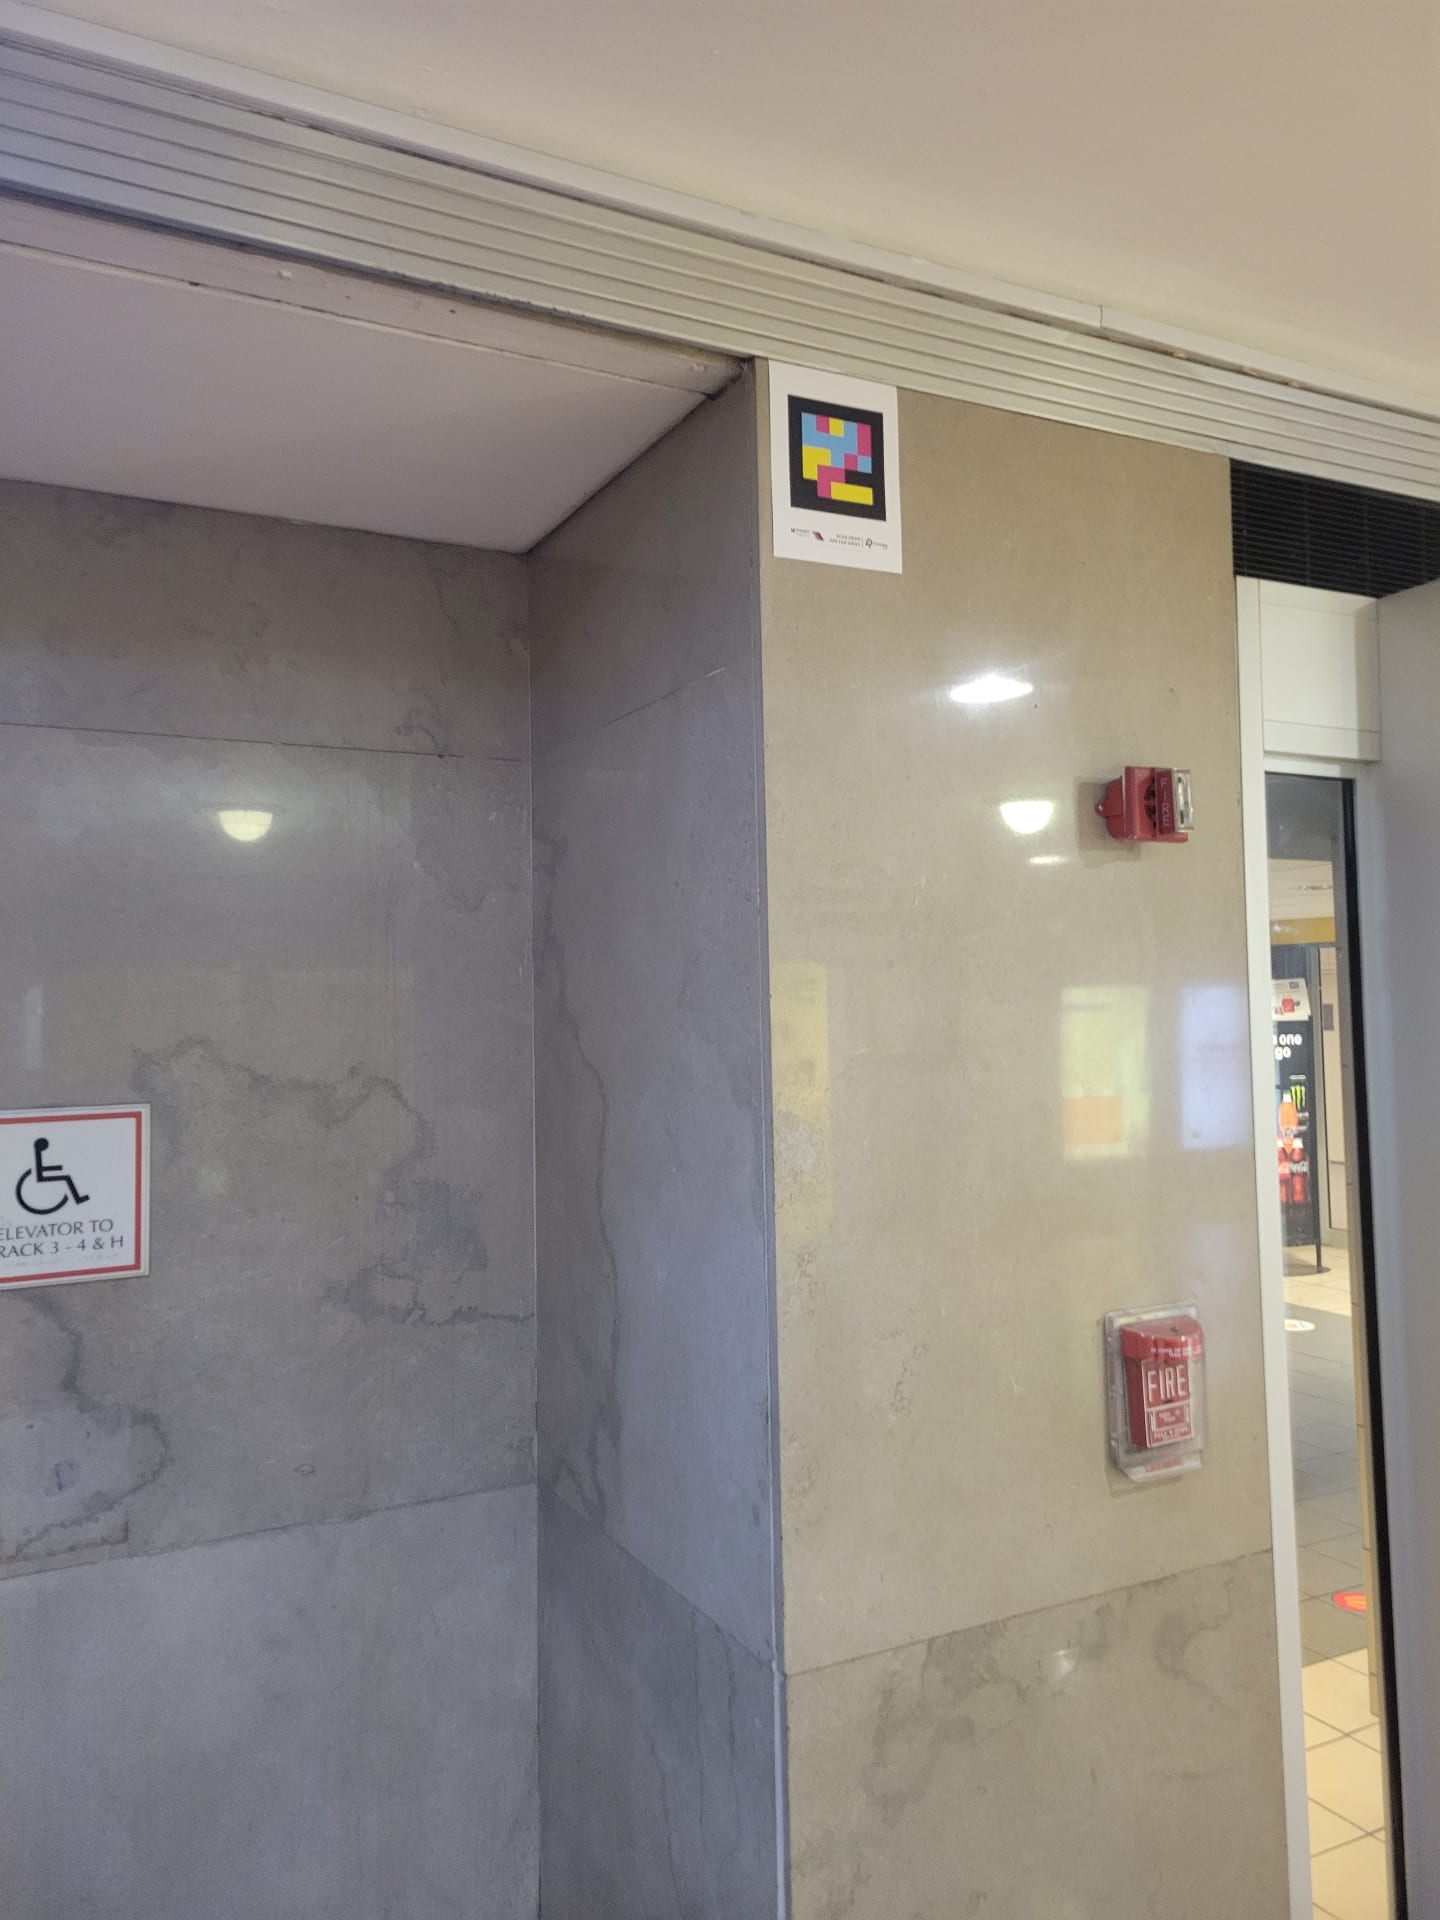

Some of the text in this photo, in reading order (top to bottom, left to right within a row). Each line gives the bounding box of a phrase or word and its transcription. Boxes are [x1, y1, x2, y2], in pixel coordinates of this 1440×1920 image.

[1160, 777, 1171, 827] FIRE
[1278, 1033, 1303, 1046] one
[1274, 1046, 1292, 1061] go
[89, 1218, 114, 1233] TO
[49, 1241, 59, 1255] 3
[77, 1239, 87, 1251] 4
[92, 1237, 105, 1250] &
[110, 1235, 124, 1249] H
[1147, 1364, 1187, 1403] FIRE
